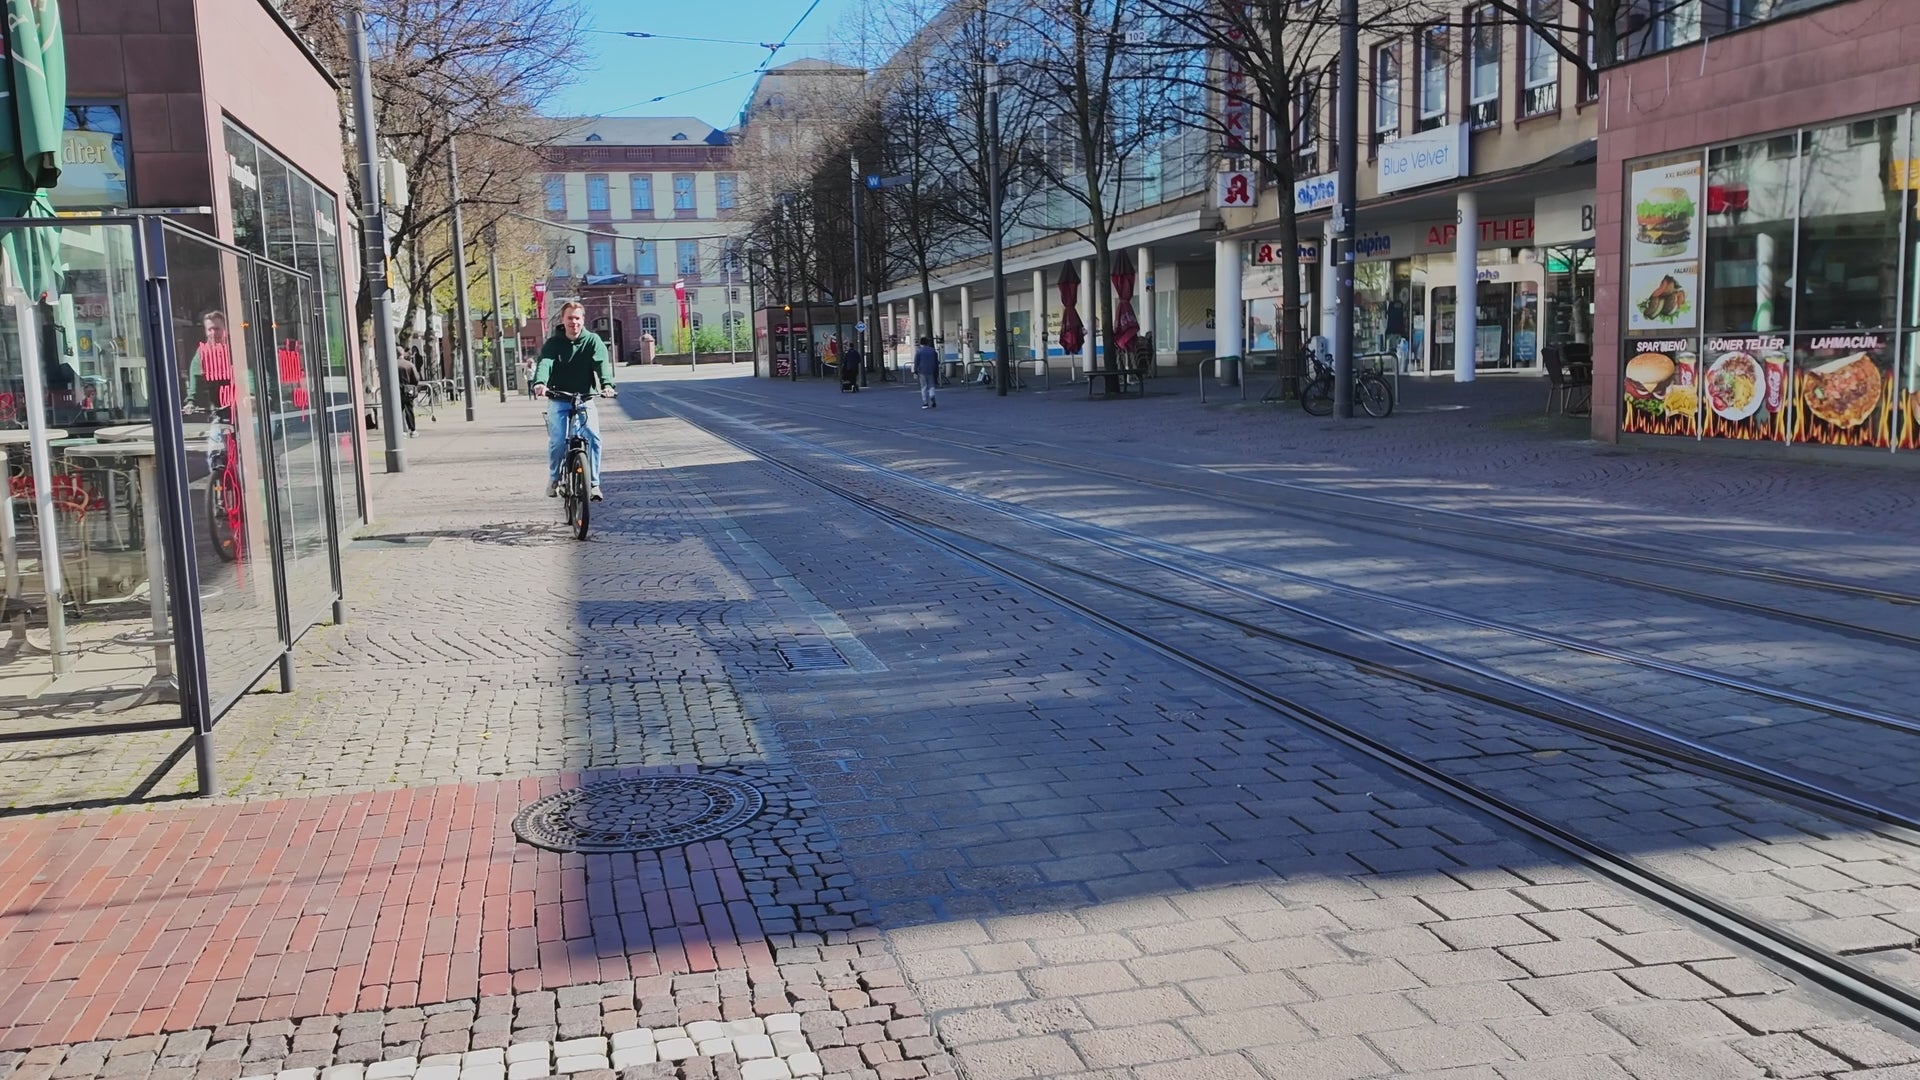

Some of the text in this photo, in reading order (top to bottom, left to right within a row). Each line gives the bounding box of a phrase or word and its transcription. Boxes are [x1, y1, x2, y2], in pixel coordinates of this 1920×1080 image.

[1129, 32, 1145, 41] 102
[1383, 144, 1448, 176] Blue Velvet
[1676, 168, 1697, 178] BURGER
[868, 176, 879, 186] W
[1476, 269, 1500, 281] lpha
[1636, 341, 1659, 352] SPAR
[1709, 337, 1785, 351] DÖNER TELLER
[1810, 336, 1878, 349] LAHMACUN
